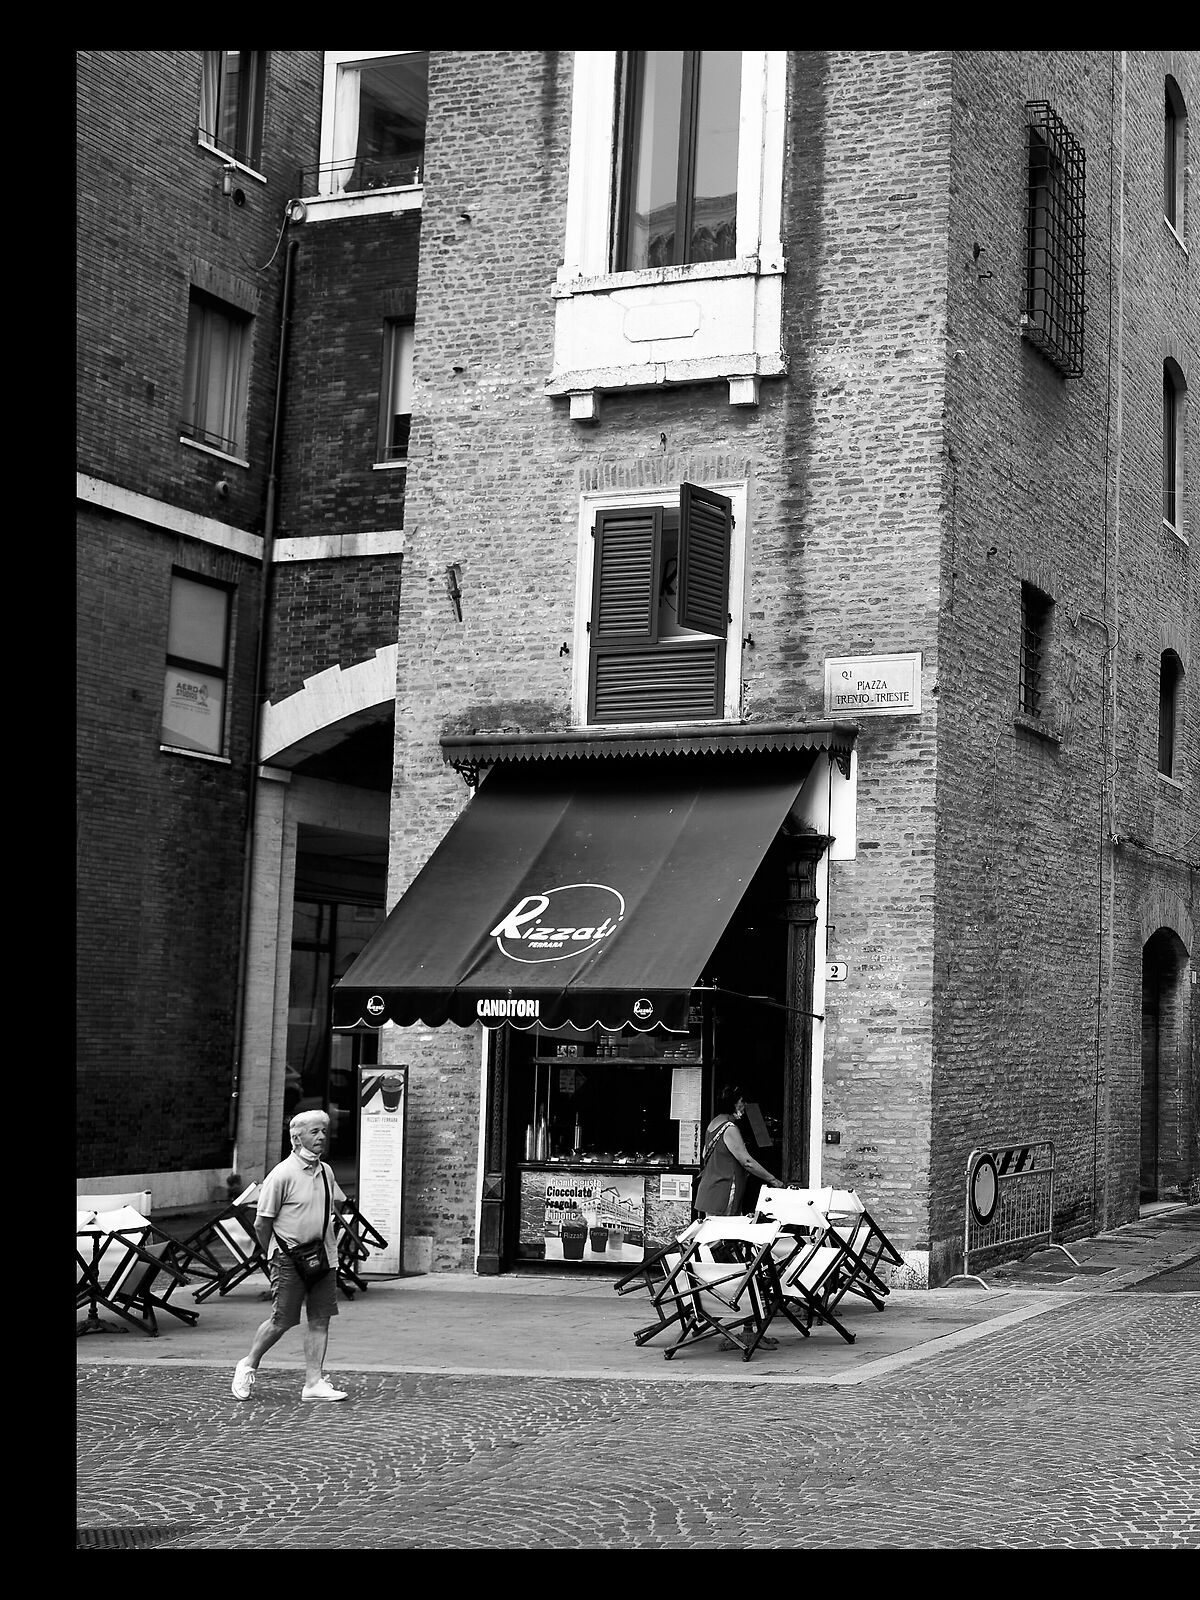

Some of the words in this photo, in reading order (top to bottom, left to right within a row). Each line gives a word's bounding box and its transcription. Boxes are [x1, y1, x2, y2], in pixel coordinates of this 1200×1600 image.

[857, 680, 887, 690] PIAZZA
[836, 694, 870, 705] TRENTO
[877, 692, 909, 702] TRIESTE
[489, 895, 624, 940] Rizzati
[830, 965, 839, 978] 2
[476, 999, 540, 1017] CANDITORI
[546, 1198, 577, 1210] Fragola
